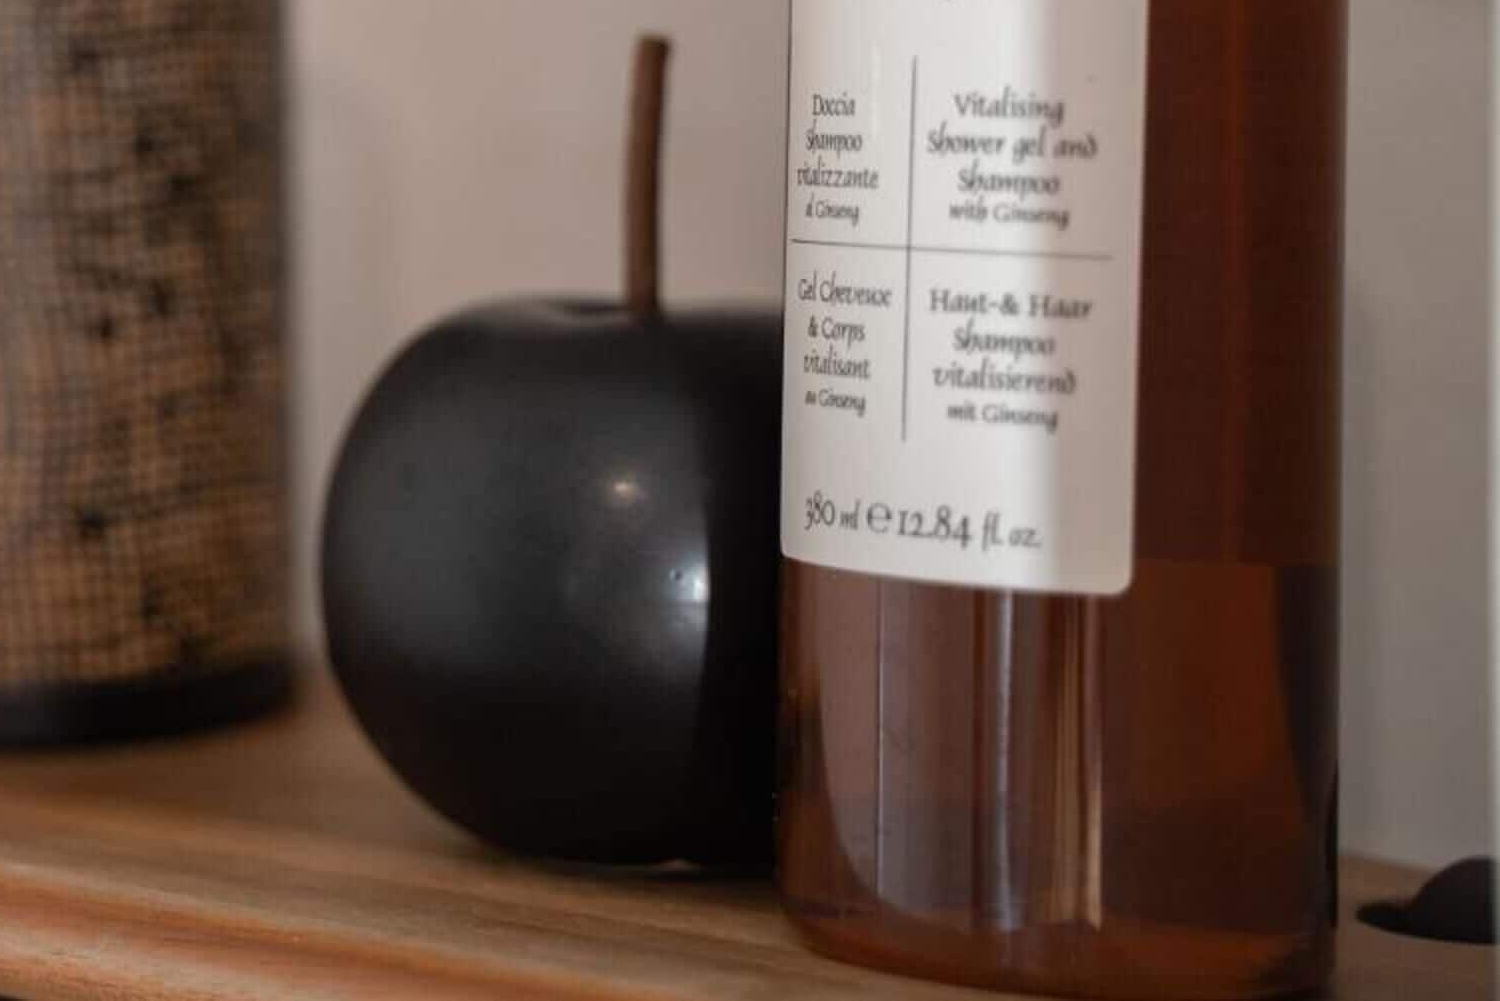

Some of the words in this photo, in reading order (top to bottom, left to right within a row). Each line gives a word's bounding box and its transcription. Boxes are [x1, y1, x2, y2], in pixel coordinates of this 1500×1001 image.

[812, 92, 855, 116] Doccia
[954, 84, 1065, 129] Vitalising
[805, 118, 863, 159] Shampoo
[927, 120, 1004, 156] Shower
[1012, 125, 1046, 164] gel
[1052, 133, 1098, 159] and
[957, 158, 1061, 201] Shampoo
[949, 195, 988, 223] with
[993, 202, 1070, 231] Ginseng
[798, 269, 817, 301] Gel
[1027, 294, 1093, 319] Haar
[821, 316, 866, 351] Corps
[953, 317, 1056, 360] Shampoo
[803, 344, 871, 380] vitalisant
[932, 357, 1076, 395] vitalisierend
[947, 400, 976, 422] mit
[981, 402, 1059, 435] Ginseng
[804, 489, 836, 532] 380
[840, 499, 860, 531] ml
[897, 504, 973, 550] 12.84
